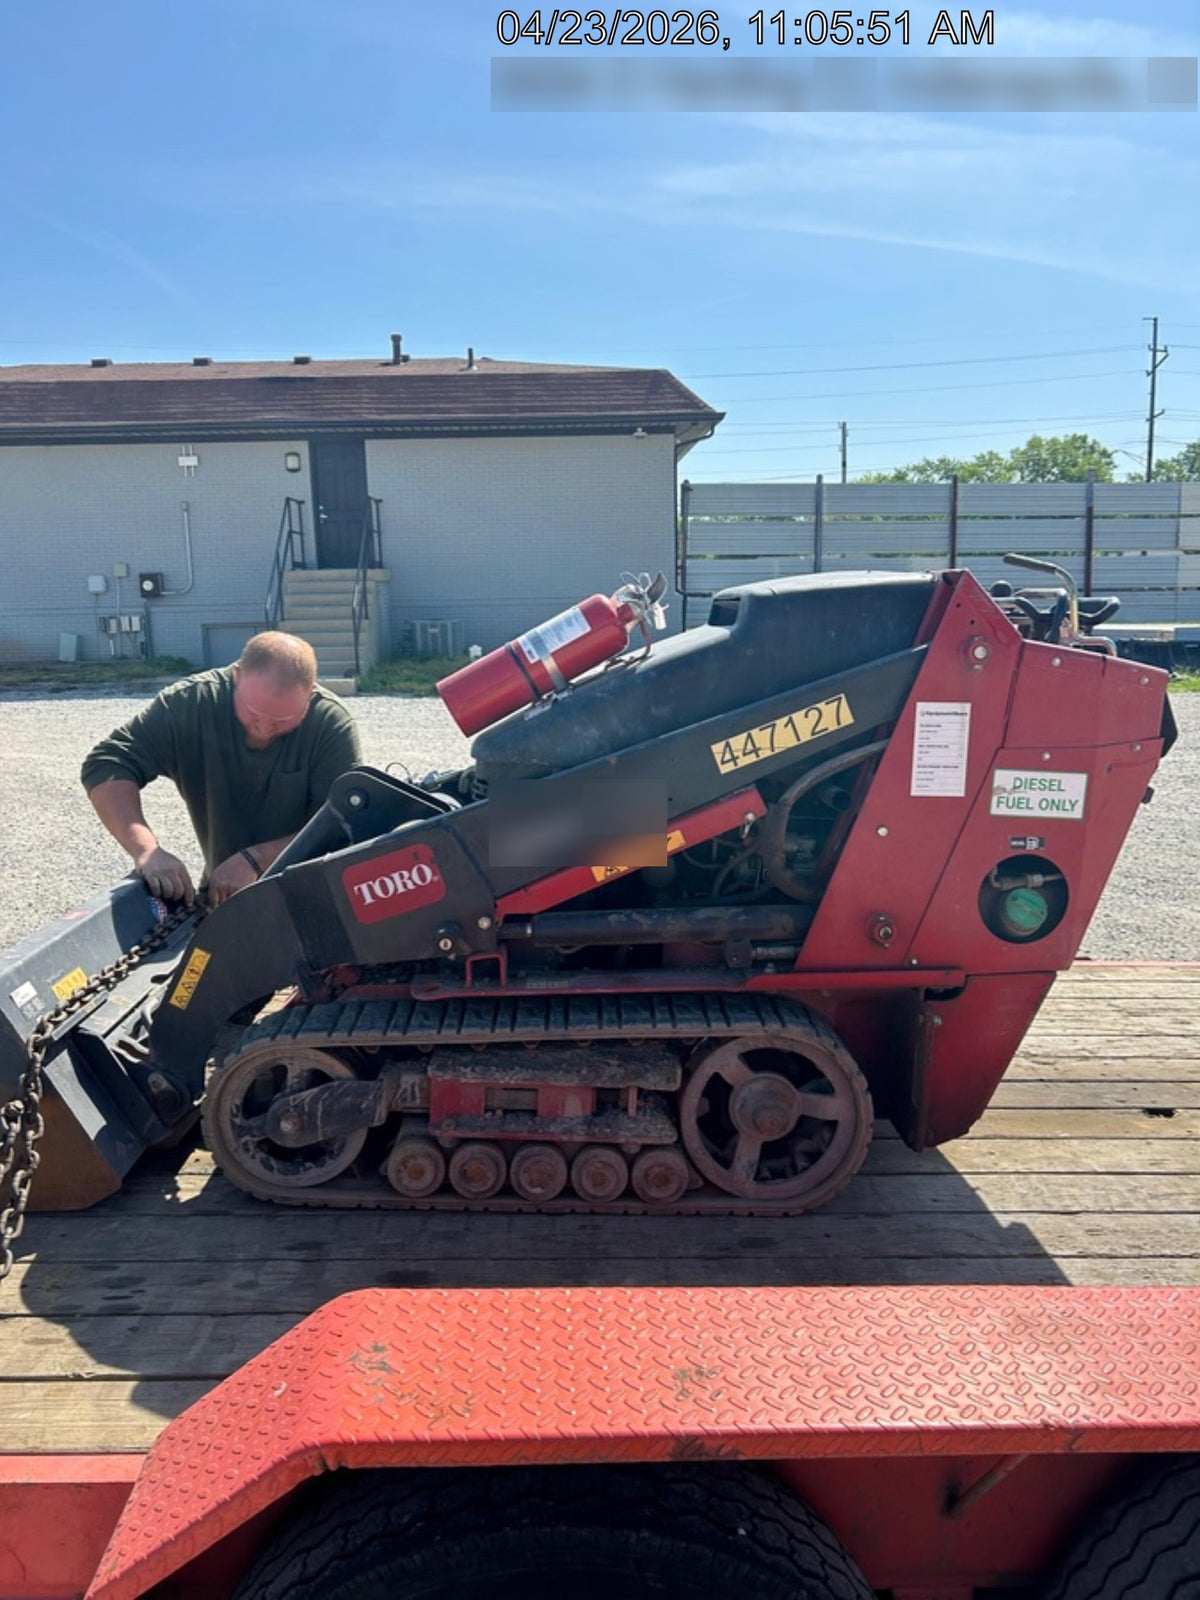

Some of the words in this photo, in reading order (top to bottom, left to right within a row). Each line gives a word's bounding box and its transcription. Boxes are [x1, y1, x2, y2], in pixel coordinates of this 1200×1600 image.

[720, 697, 843, 767] 447127
[1013, 777, 1066, 792] DIESEL
[996, 796, 1034, 810] FUEL
[1038, 798, 1079, 811] ONLY
[353, 864, 432, 905] TORO
